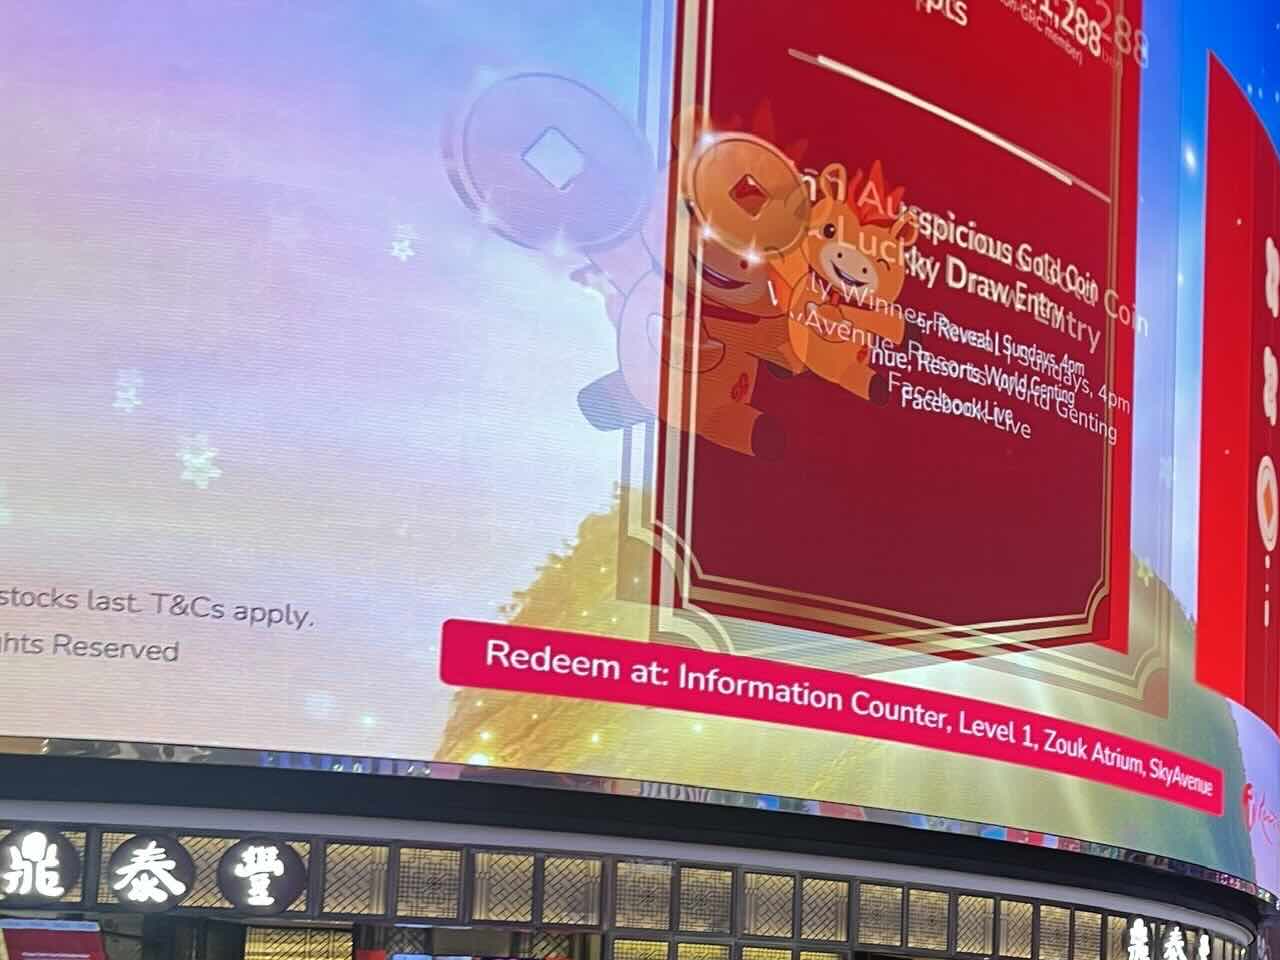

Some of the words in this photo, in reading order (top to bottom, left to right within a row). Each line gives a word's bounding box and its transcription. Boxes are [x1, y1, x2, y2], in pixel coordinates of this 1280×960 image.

[151, 592, 225, 620] T&Cs
[232, 602, 316, 630] apply.
[0, 631, 44, 655] hts
[52, 633, 180, 663] Reserved
[485, 638, 620, 680] Redeem
[630, 662, 669, 687] at:
[679, 664, 843, 712] Information
[851, 691, 952, 734] Counter,
[958, 711, 1016, 744] Level
[1022, 725, 1040, 752] 1,
[1044, 729, 1088, 761] Zouk
[1091, 742, 1147, 777] Atrium,
[1149, 757, 1214, 797] SkyAvenue
